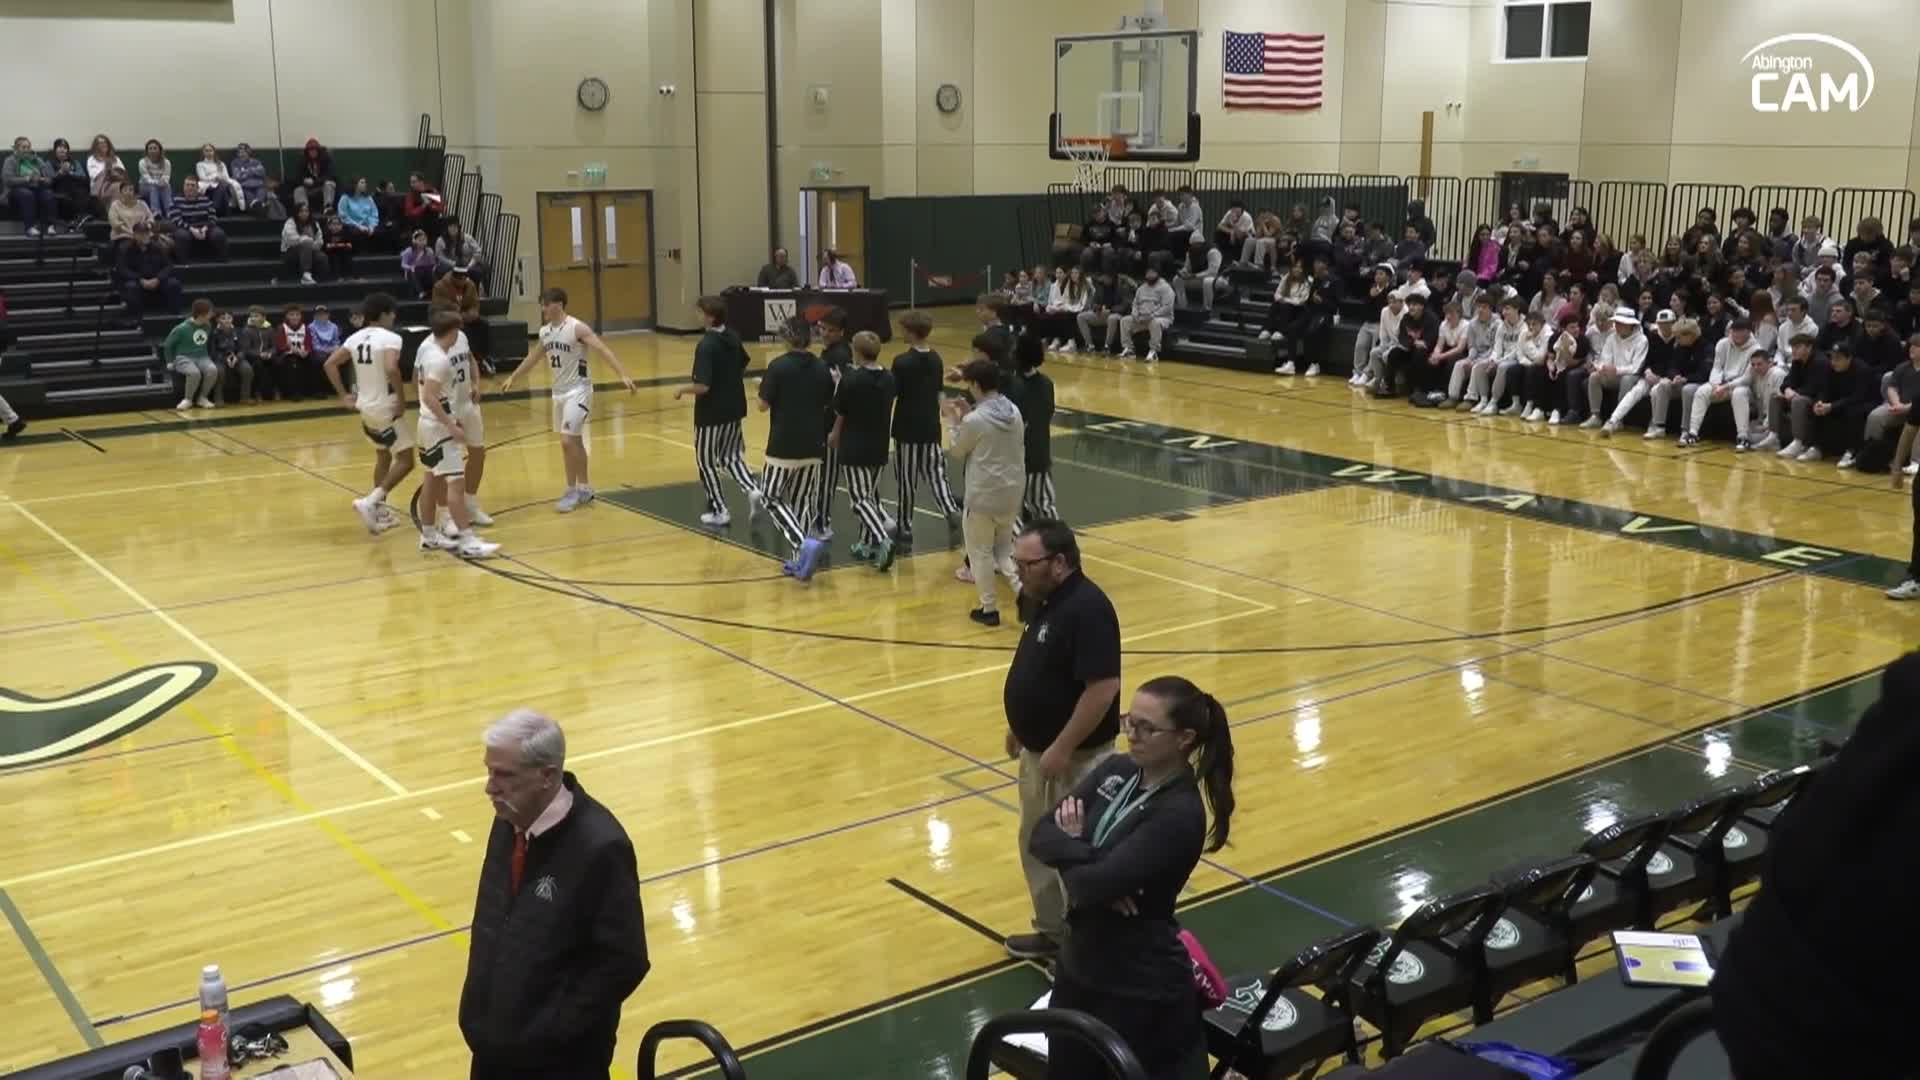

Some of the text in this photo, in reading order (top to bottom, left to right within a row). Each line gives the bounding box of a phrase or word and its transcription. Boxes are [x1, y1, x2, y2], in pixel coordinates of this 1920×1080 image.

[768, 303, 794, 322] W
[357, 344, 373, 365] 11
[550, 354, 562, 368] 21
[1331, 464, 1843, 567] WAVE
